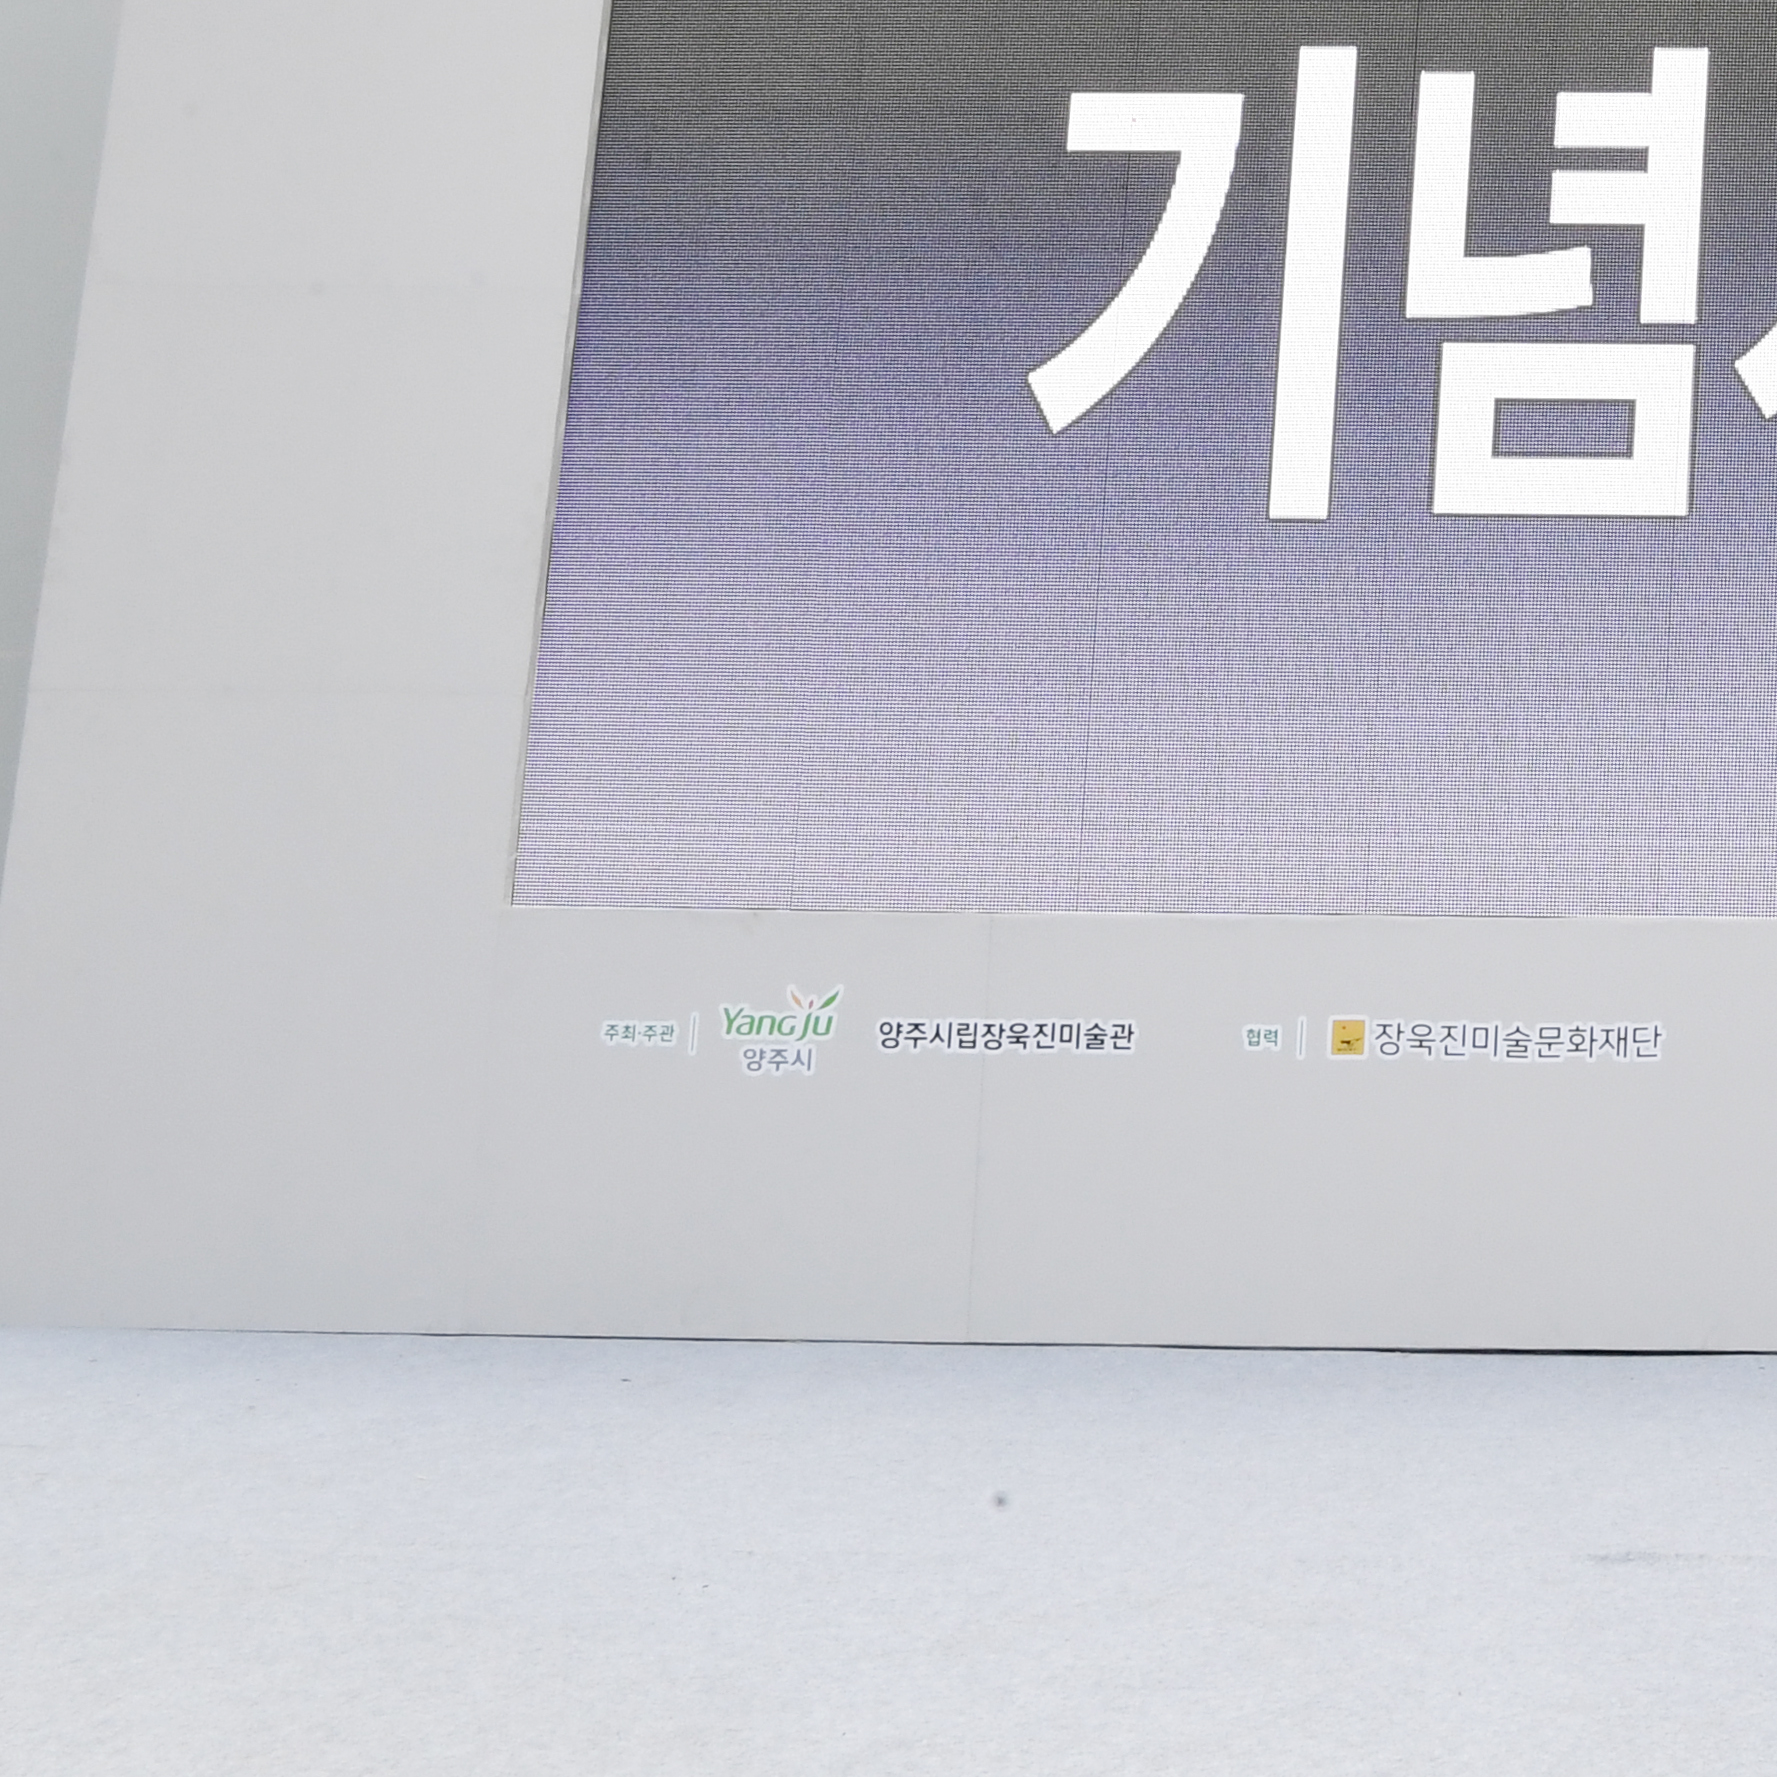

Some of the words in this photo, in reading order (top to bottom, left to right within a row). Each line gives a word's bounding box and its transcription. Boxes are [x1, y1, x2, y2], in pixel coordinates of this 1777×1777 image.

[878, 1020, 1136, 1052] 양주시립장욱진미술관
[1245, 1027, 1279, 1047] 협력
[1374, 1022, 1663, 1060] 장욱진미술문화재단
[743, 1048, 813, 1072] 양주시
